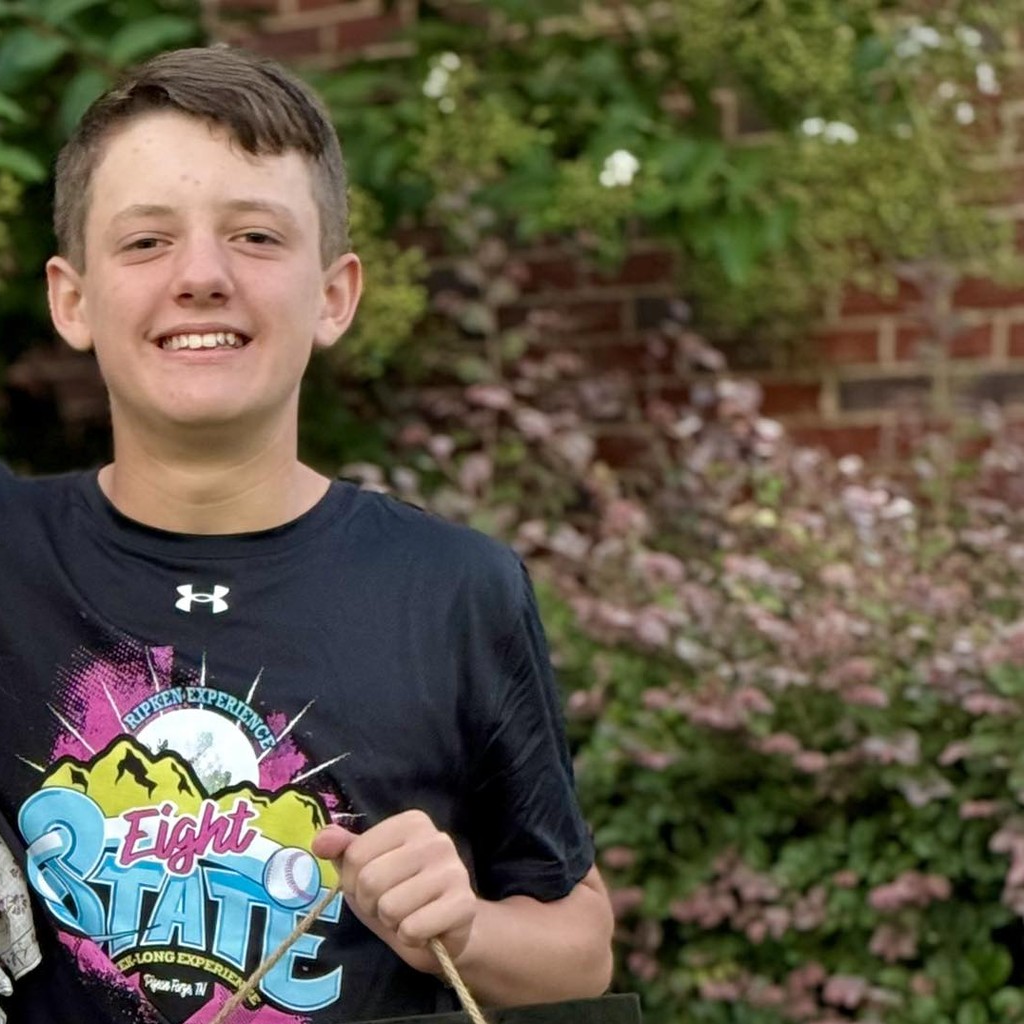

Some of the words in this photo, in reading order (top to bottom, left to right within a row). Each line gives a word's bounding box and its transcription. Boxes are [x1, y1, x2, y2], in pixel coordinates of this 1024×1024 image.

[123, 686, 183, 730] RIPKEN
[185, 686, 276, 751] EXPERIENCE
[120, 801, 258, 874] Eight
[115, 950, 175, 972] EK-LONG
[177, 951, 262, 1006] EXPERIENE
